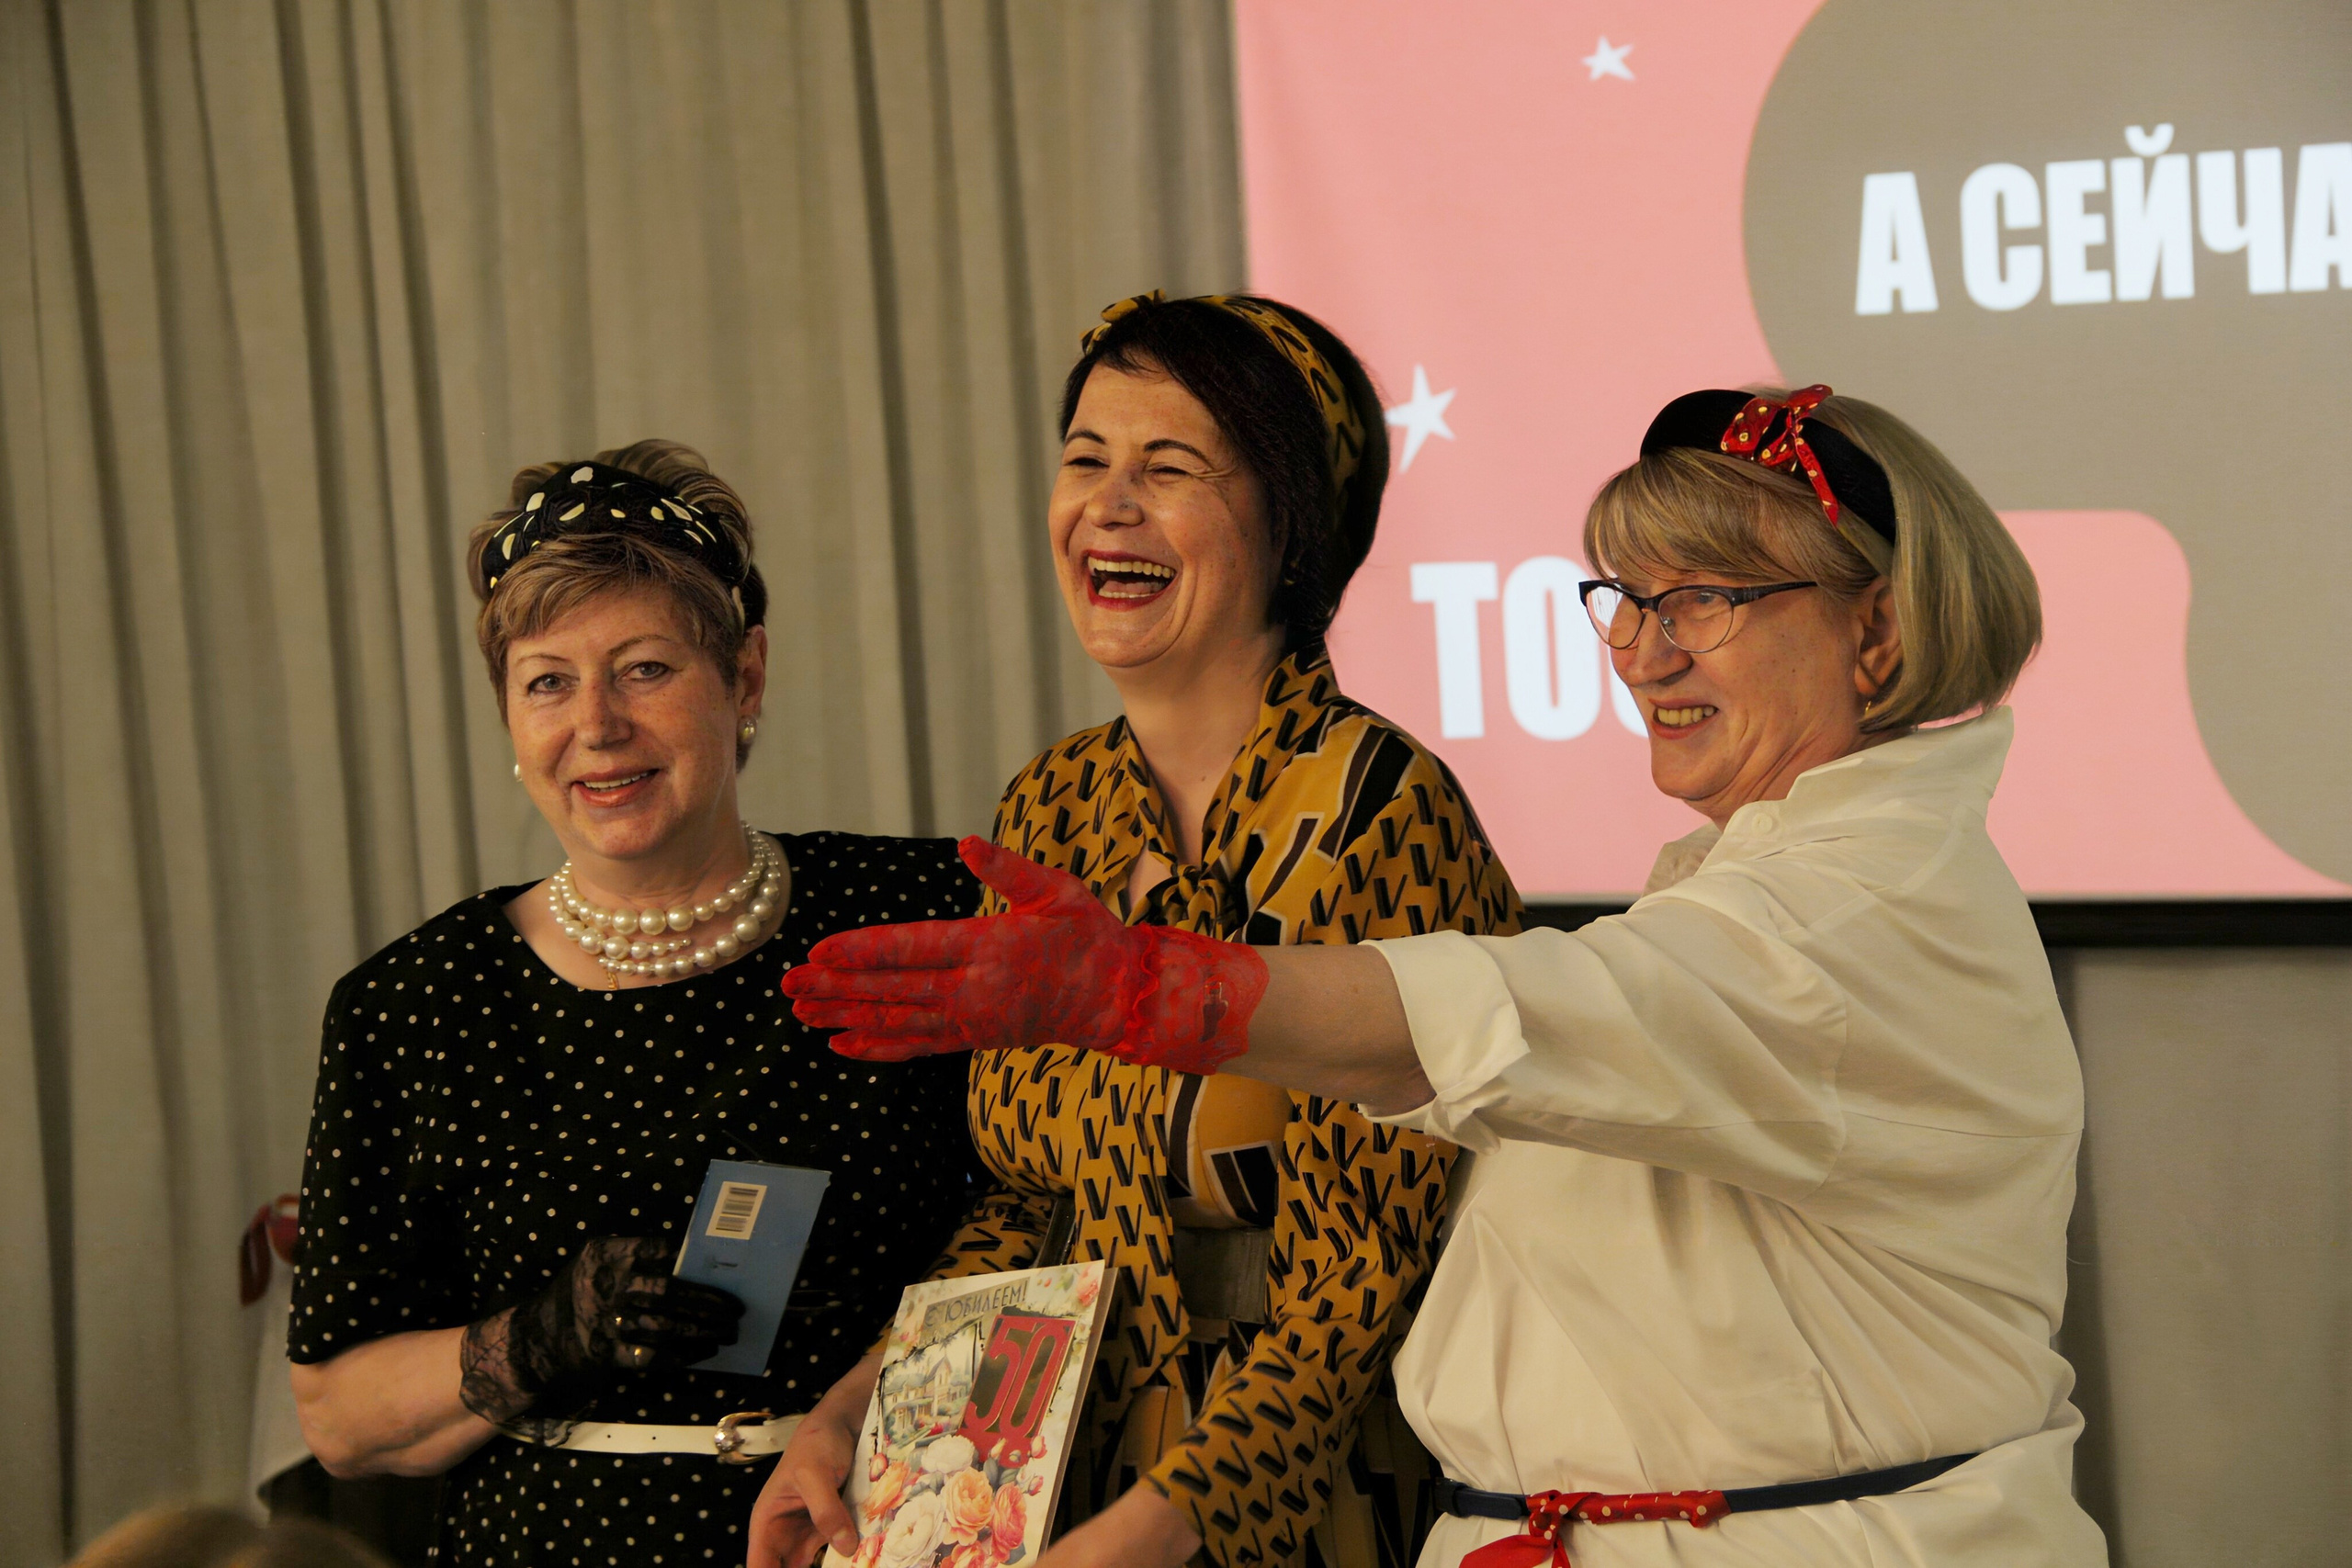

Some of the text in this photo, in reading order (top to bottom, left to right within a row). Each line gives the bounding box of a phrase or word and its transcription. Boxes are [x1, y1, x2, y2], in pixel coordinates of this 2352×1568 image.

[1855, 122, 2352, 315] А СЕЙЧА
[944, 1280, 1028, 1323] ЮБИЛЕЕМ!
[962, 1315, 1073, 1437] 50
